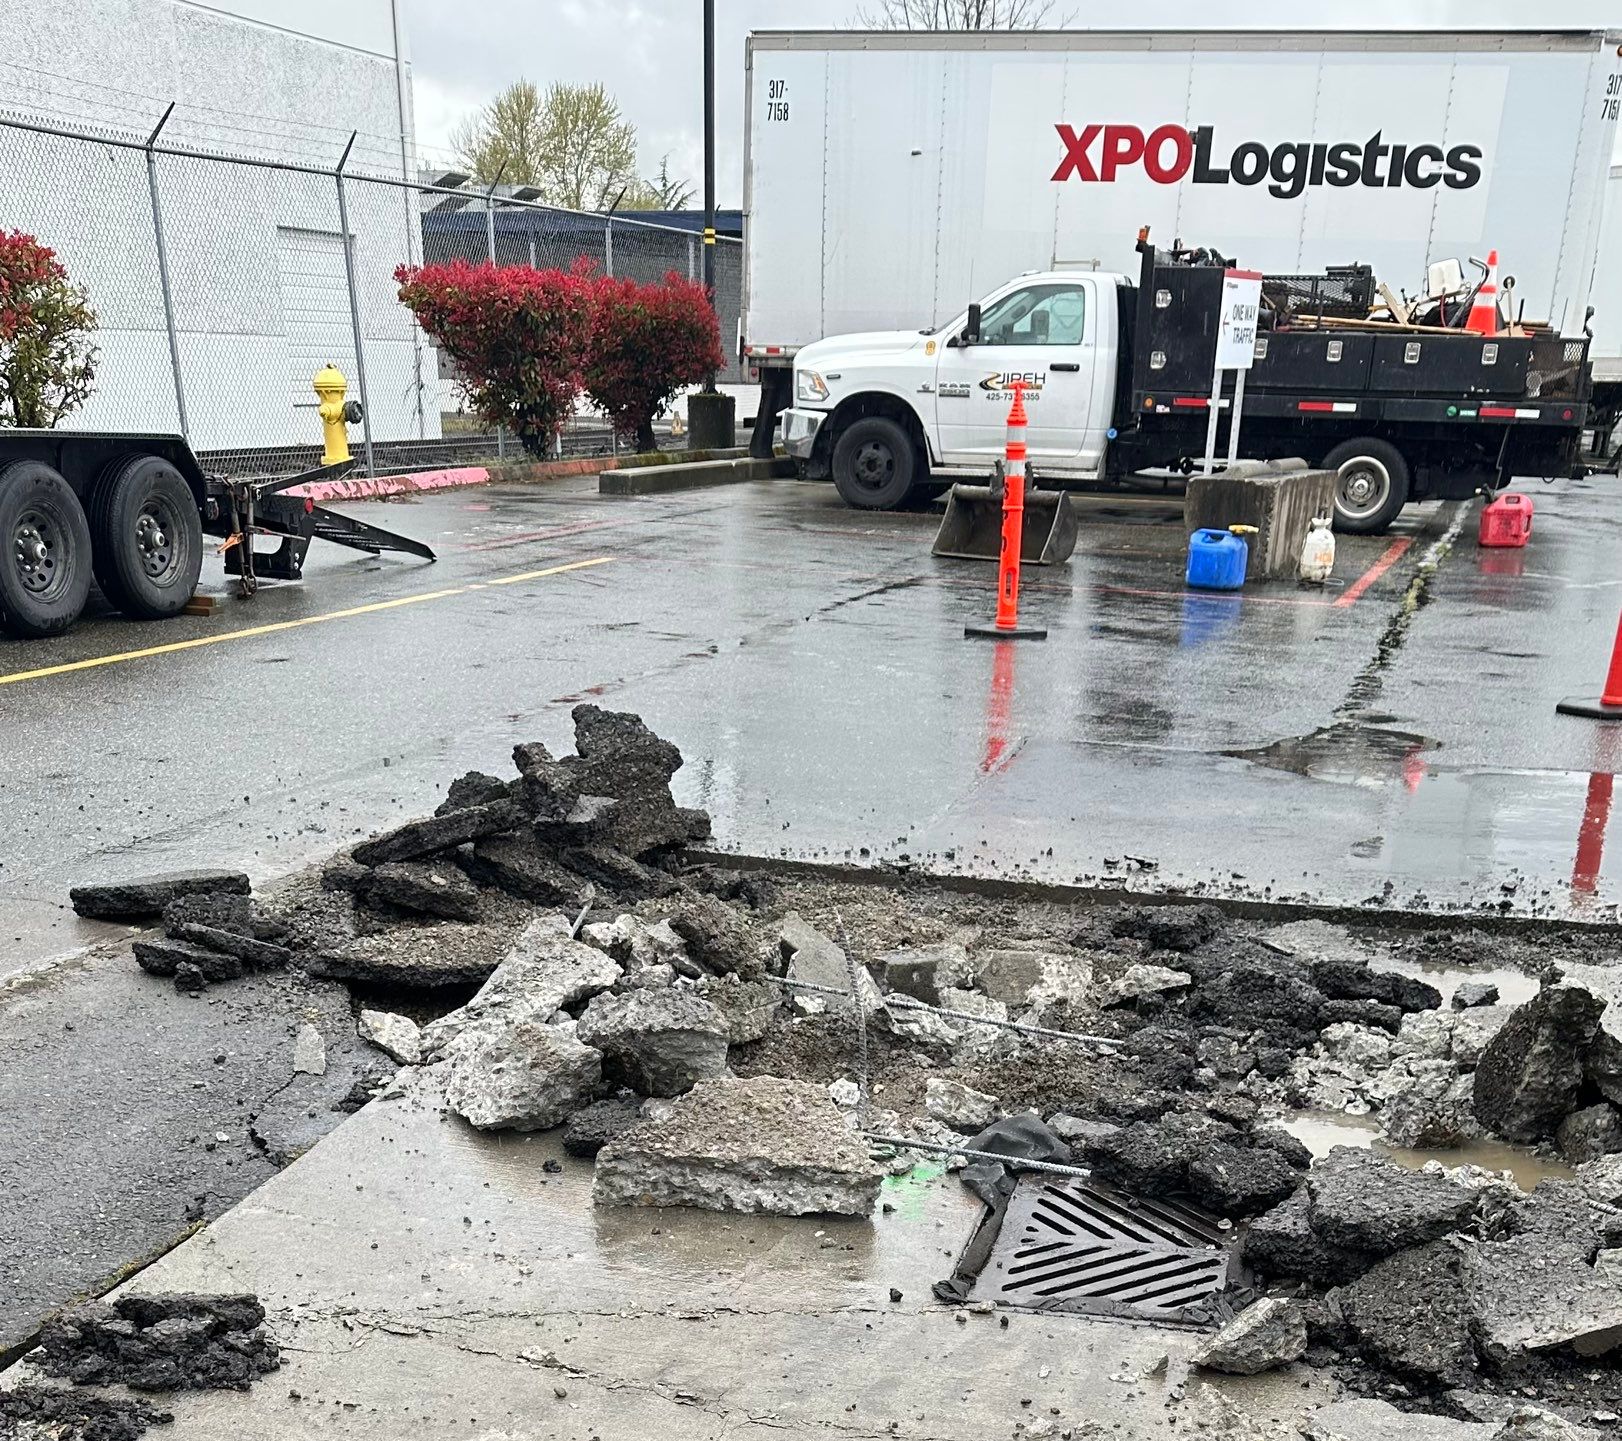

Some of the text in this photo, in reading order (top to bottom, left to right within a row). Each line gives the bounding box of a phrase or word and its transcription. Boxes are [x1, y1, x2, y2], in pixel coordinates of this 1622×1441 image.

[767, 102, 789, 121] 7158
[1232, 304, 1257, 321] ONE WAY
[1232, 327, 1254, 344] TRAFFIC
